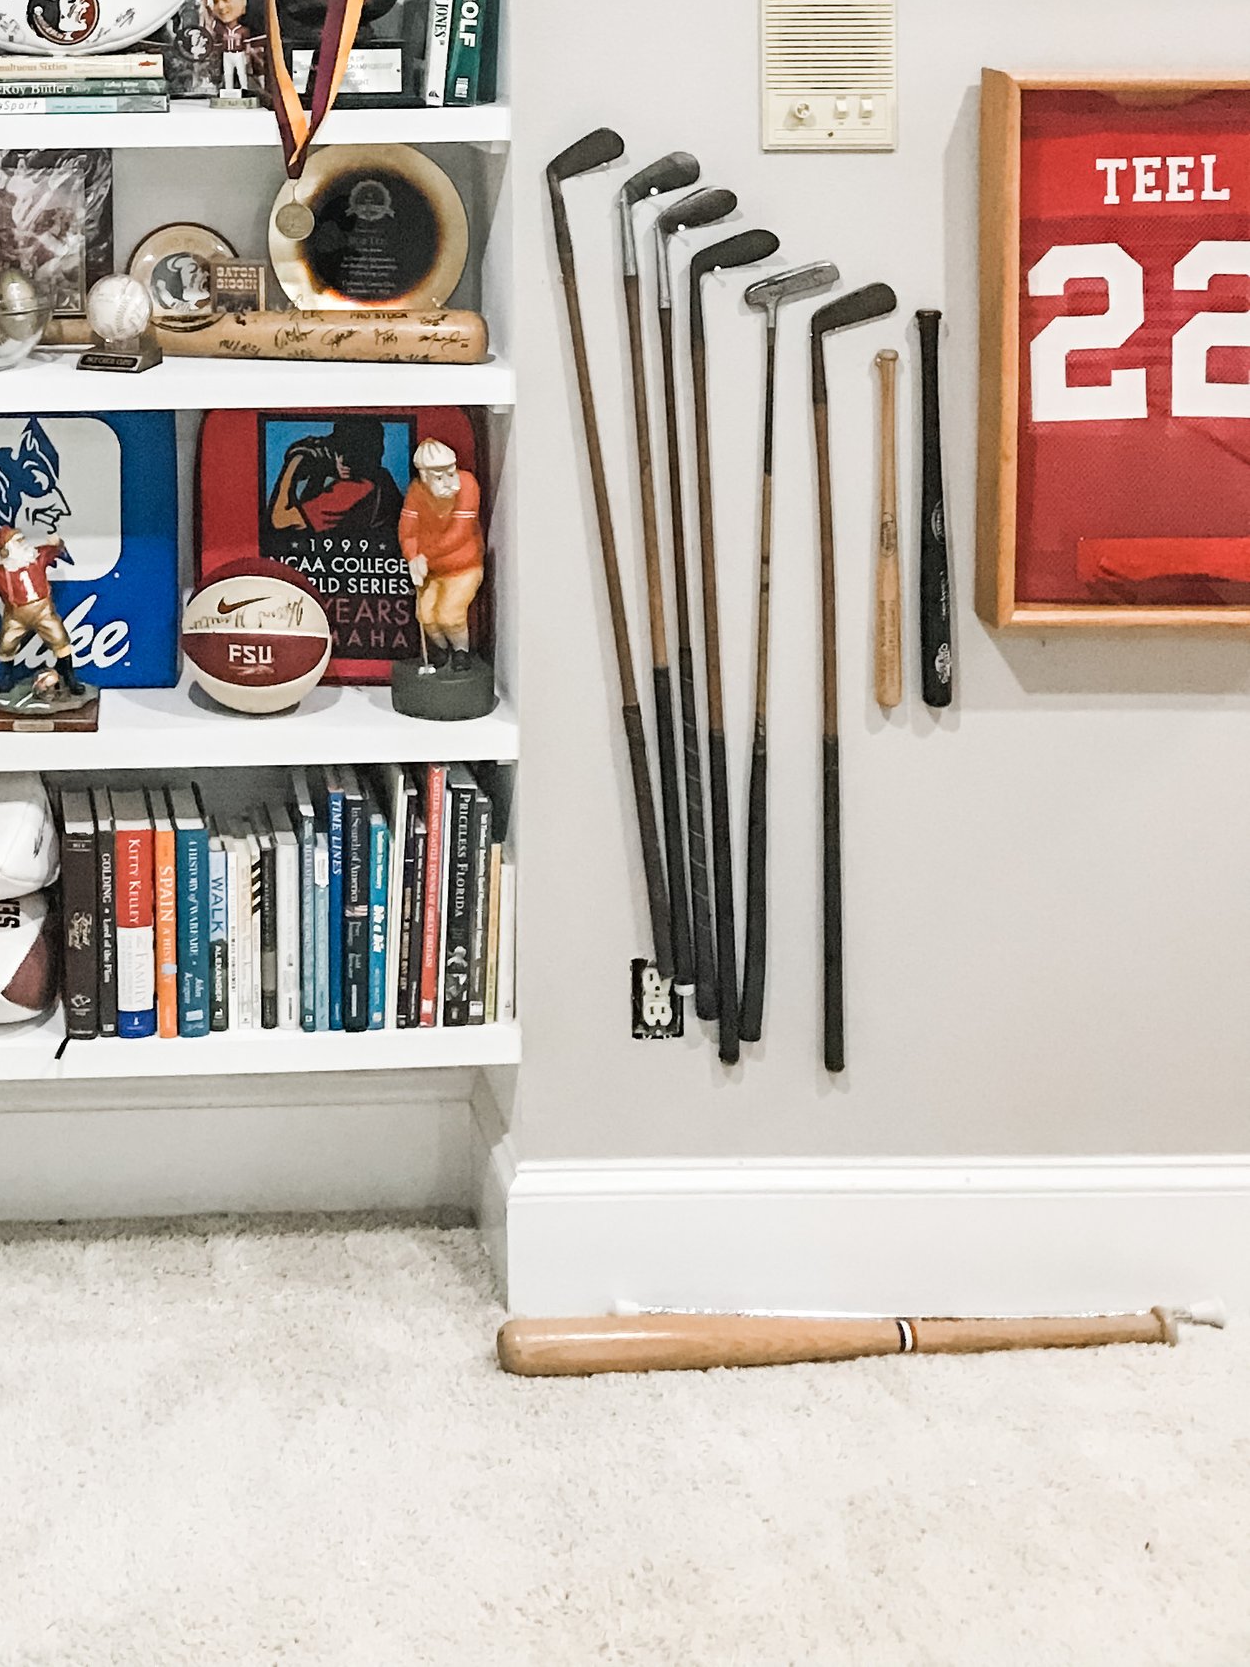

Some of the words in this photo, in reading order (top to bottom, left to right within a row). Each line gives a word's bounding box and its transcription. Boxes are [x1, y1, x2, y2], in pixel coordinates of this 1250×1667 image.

[434, 2, 450, 39] JONES
[39, 62, 68, 72] Sixties
[30, 83, 70, 95] Butler
[1095, 154, 1231, 204] TEEL
[1026, 239, 1250, 422] 22
[309, 538, 370, 552] 1999
[331, 557, 410, 574] COLLEGE
[18, 572, 36, 602] 1
[347, 578, 410, 595] SERIES
[228, 644, 273, 664] FSU
[432, 776, 442, 812] CASTLES
[331, 799, 342, 832] TIME
[431, 812, 440, 830] AND
[456, 793, 472, 858] PRICELESS
[350, 818, 362, 851] Search
[430, 831, 439, 863] CASTLE
[128, 839, 142, 877] KITTY
[331, 835, 342, 876] LINES
[101, 853, 112, 903] GOLDING
[159, 865, 174, 922] SPAIN
[350, 861, 361, 903] America
[428, 864, 438, 892] TOWNS
[454, 862, 469, 918] FLORIDA
[128, 880, 143, 924] KELLEY
[211, 877, 224, 934] WALK
[103, 918, 111, 937] Lord
[426, 906, 436, 933] GREAT
[103, 949, 111, 962] the
[425, 935, 434, 968] BRITAIN
[214, 945, 223, 1002] ALEXANDER
